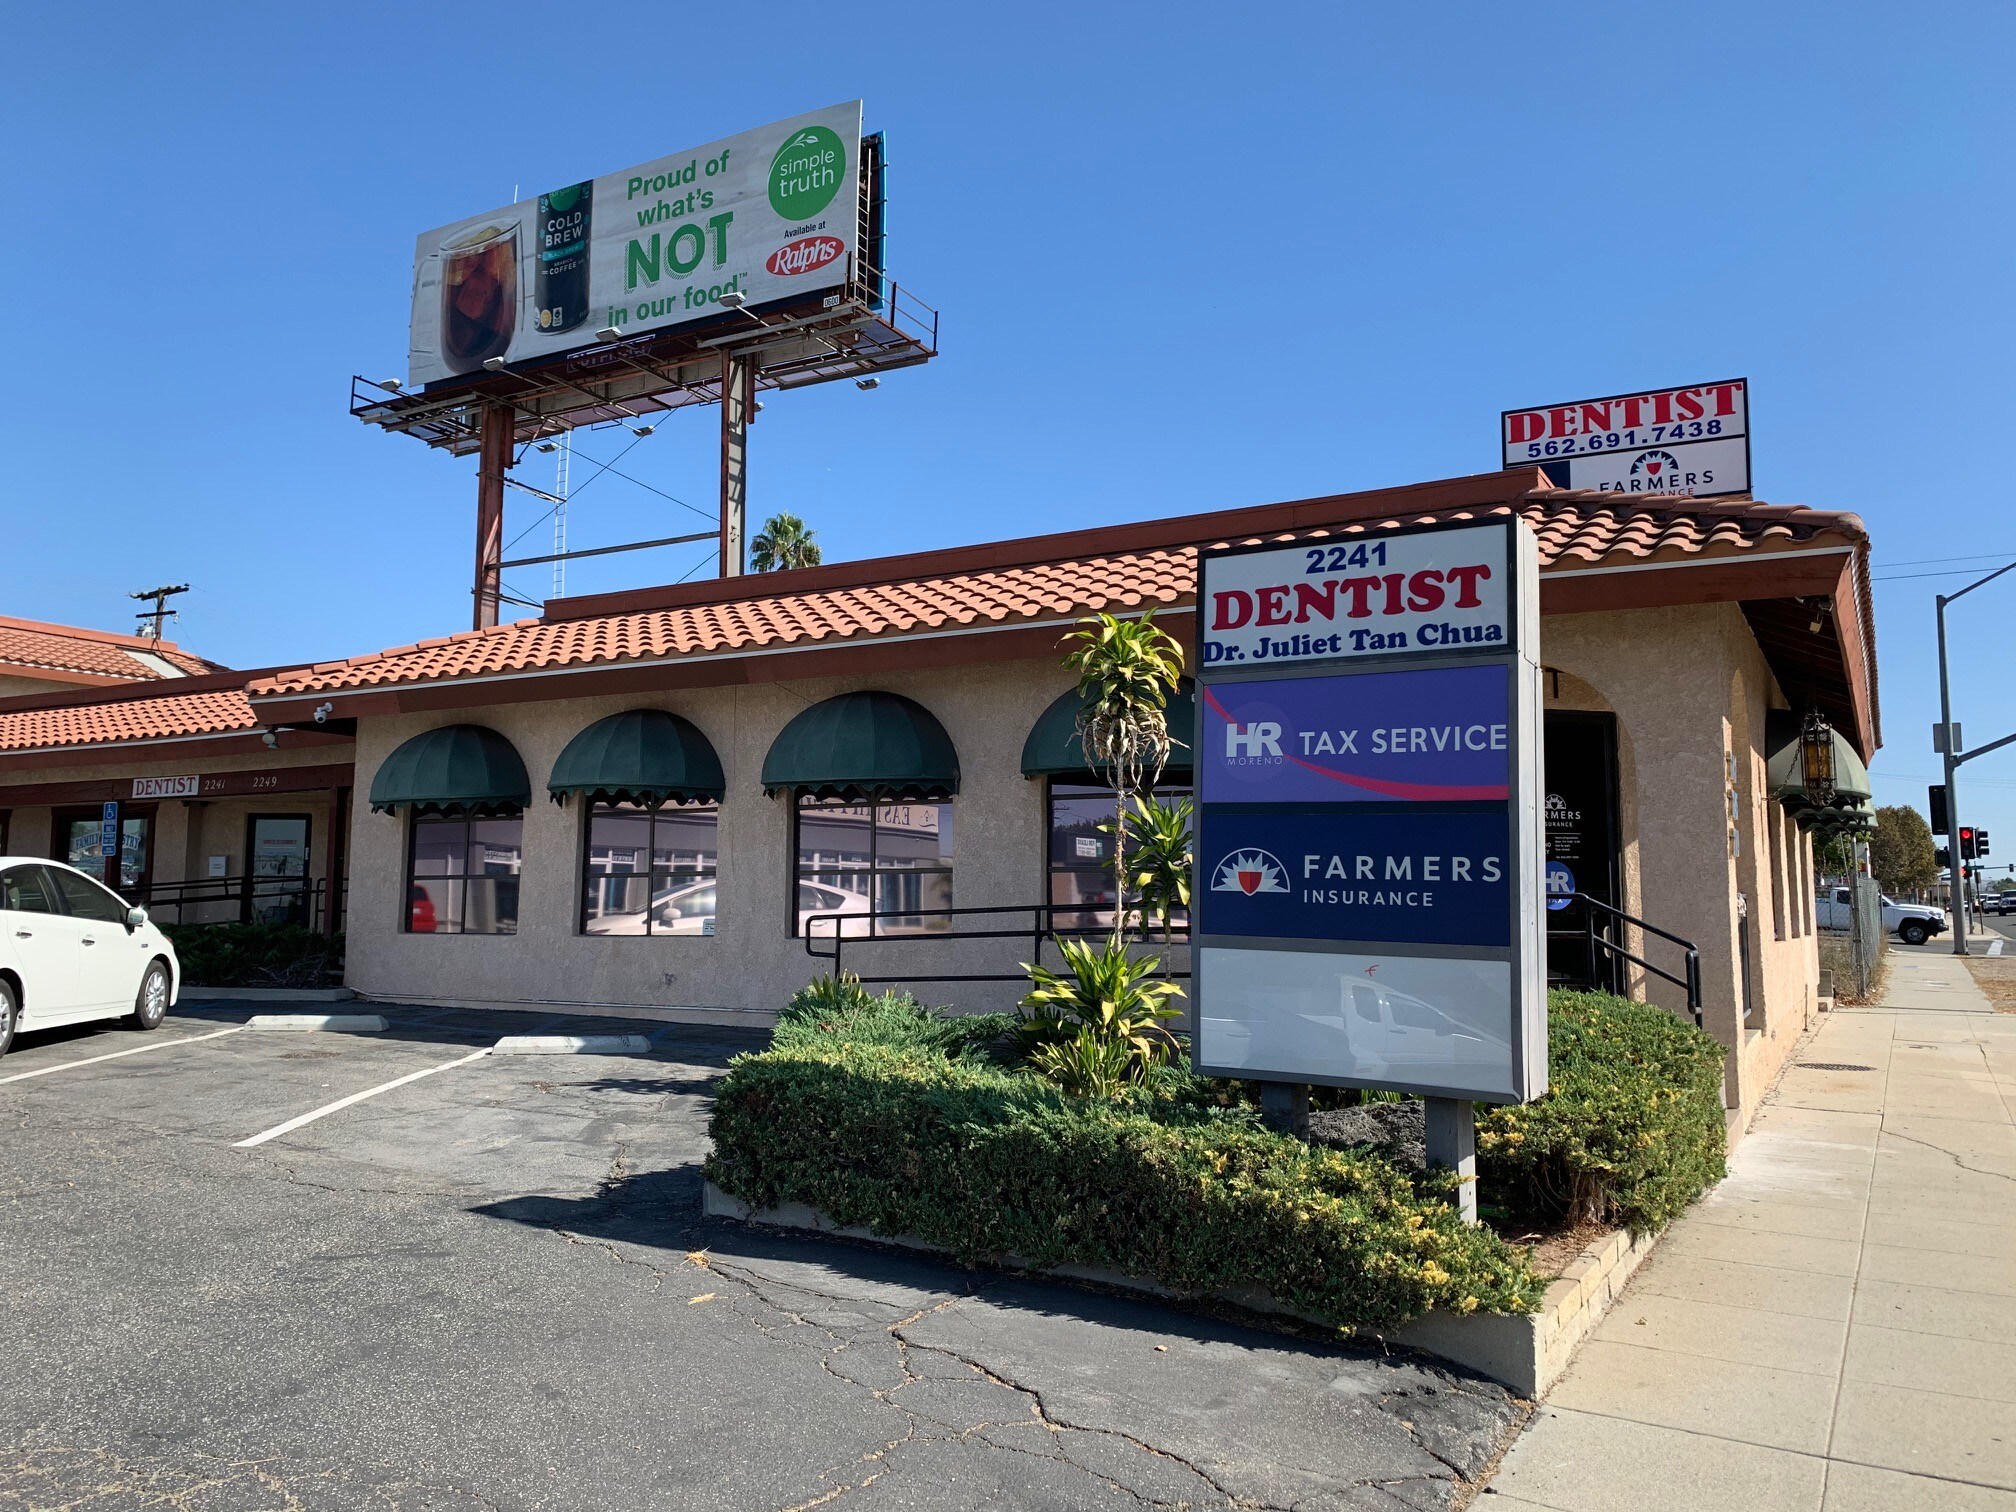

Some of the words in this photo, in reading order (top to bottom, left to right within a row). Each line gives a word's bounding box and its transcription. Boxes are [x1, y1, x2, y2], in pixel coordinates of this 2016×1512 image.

[628, 159, 697, 200] Proud
[705, 149, 730, 177] of
[780, 149, 834, 176] simple
[780, 166, 834, 198] truth
[547, 211, 582, 232] COLD
[637, 188, 714, 227] what's
[545, 224, 583, 247] BREW
[784, 225, 816, 239] Available
[818, 220, 826, 231] at
[624, 211, 734, 294] NOT
[773, 239, 836, 275] Ralphs
[549, 261, 577, 275] COFFEE
[608, 306, 628, 328] in
[636, 295, 676, 320] our
[1507, 383, 1743, 444] DENTIST
[1527, 419, 1722, 458] 562.691.7438
[1599, 470, 1714, 493] FARMERS
[1305, 541, 1387, 575] 2241
[1211, 564, 1492, 631] DENTIST
[1203, 641, 1246, 663] Dr.
[1253, 633, 1342, 660] Juliet
[1349, 628, 1408, 651] Tan
[1416, 623, 1503, 647] Chua
[1226, 721, 1284, 758] HR
[1299, 730, 1359, 756] TAX
[1371, 724, 1508, 755] SERVICE
[1227, 757, 1283, 766] MORENO
[135, 776, 196, 796] DENTIST
[204, 779, 226, 791] 2241
[252, 776, 278, 788] 2249
[1304, 855, 1502, 882] FARMERS
[1304, 889, 1433, 907] INSURANCE
